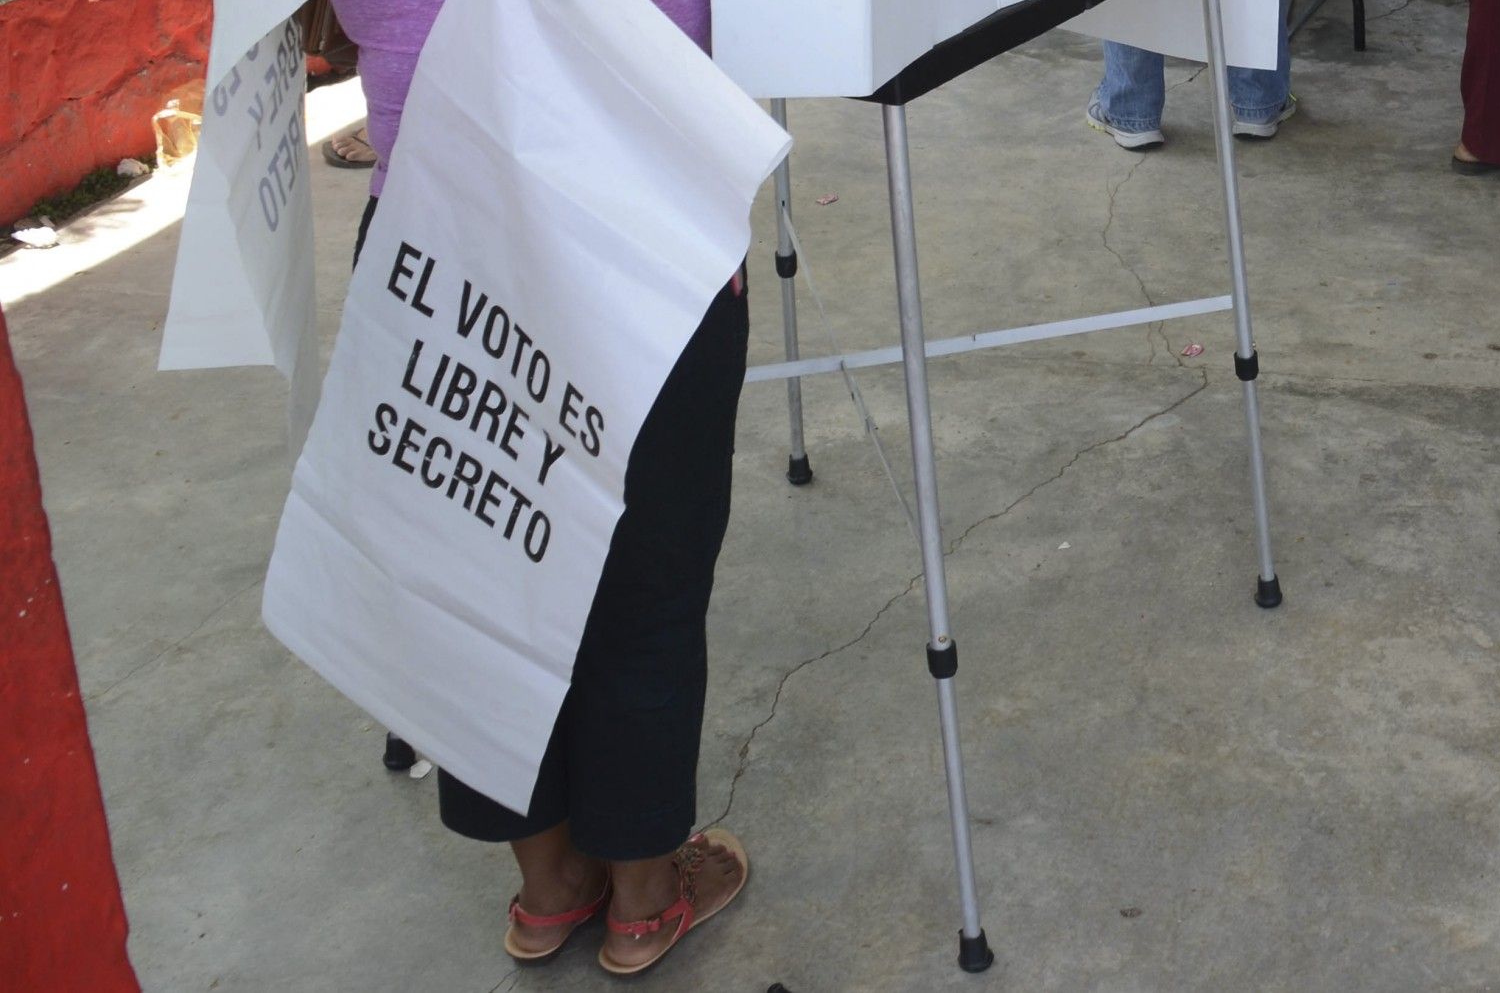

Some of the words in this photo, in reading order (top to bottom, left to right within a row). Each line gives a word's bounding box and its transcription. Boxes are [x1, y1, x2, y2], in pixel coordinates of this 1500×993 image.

[387, 241, 436, 318] EL
[457, 279, 551, 404] VOTO
[558, 381, 605, 458] ES
[401, 339, 531, 462] LIBRE
[537, 429, 566, 486] Y
[367, 402, 552, 564] SECRETO
